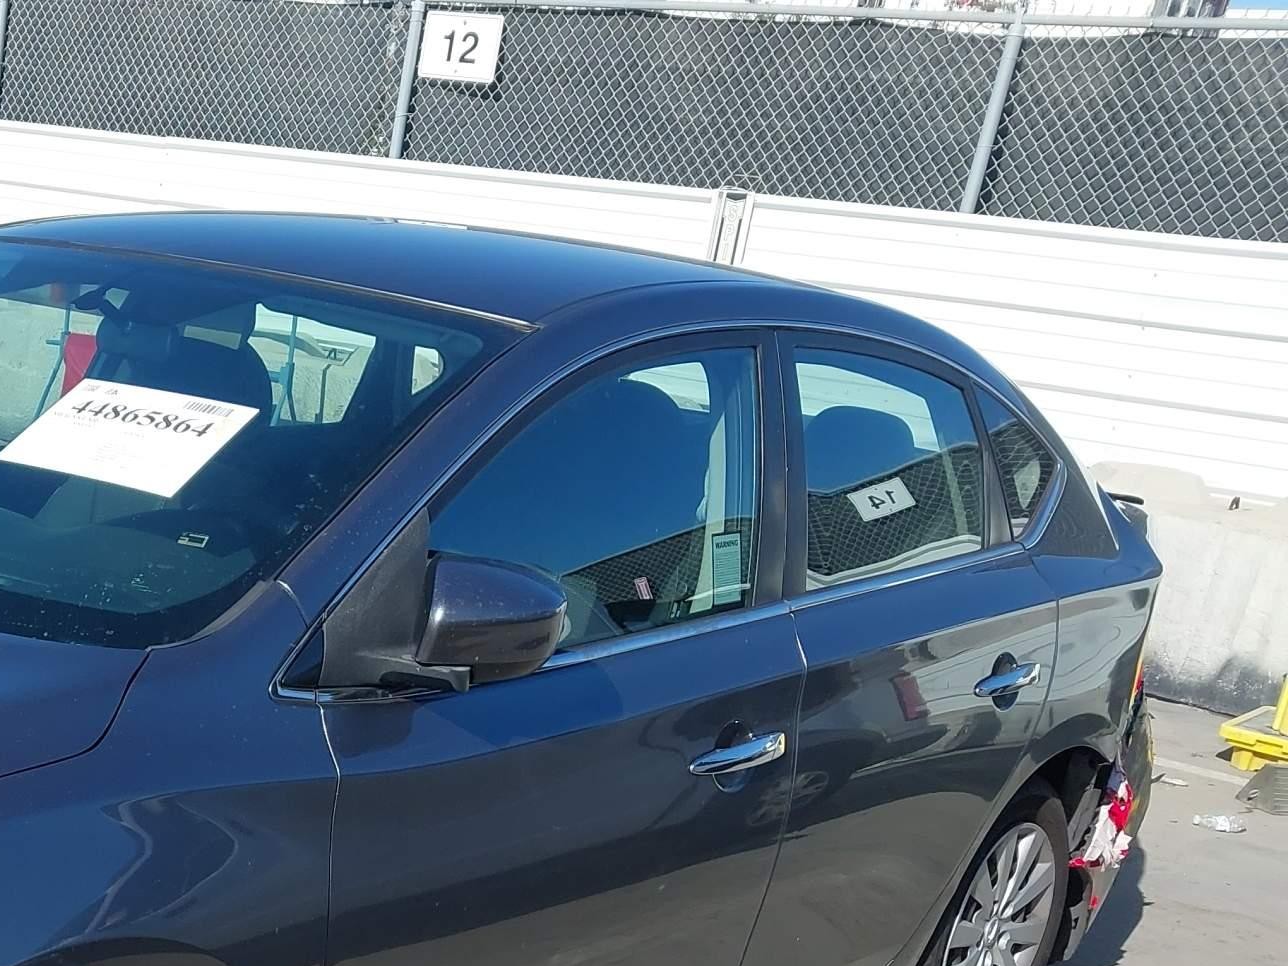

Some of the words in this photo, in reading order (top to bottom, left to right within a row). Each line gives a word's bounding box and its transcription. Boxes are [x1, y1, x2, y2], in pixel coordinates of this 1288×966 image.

[444, 29, 479, 64] 12
[72, 399, 215, 437] 44865864
[715, 539, 739, 549] WARNING
